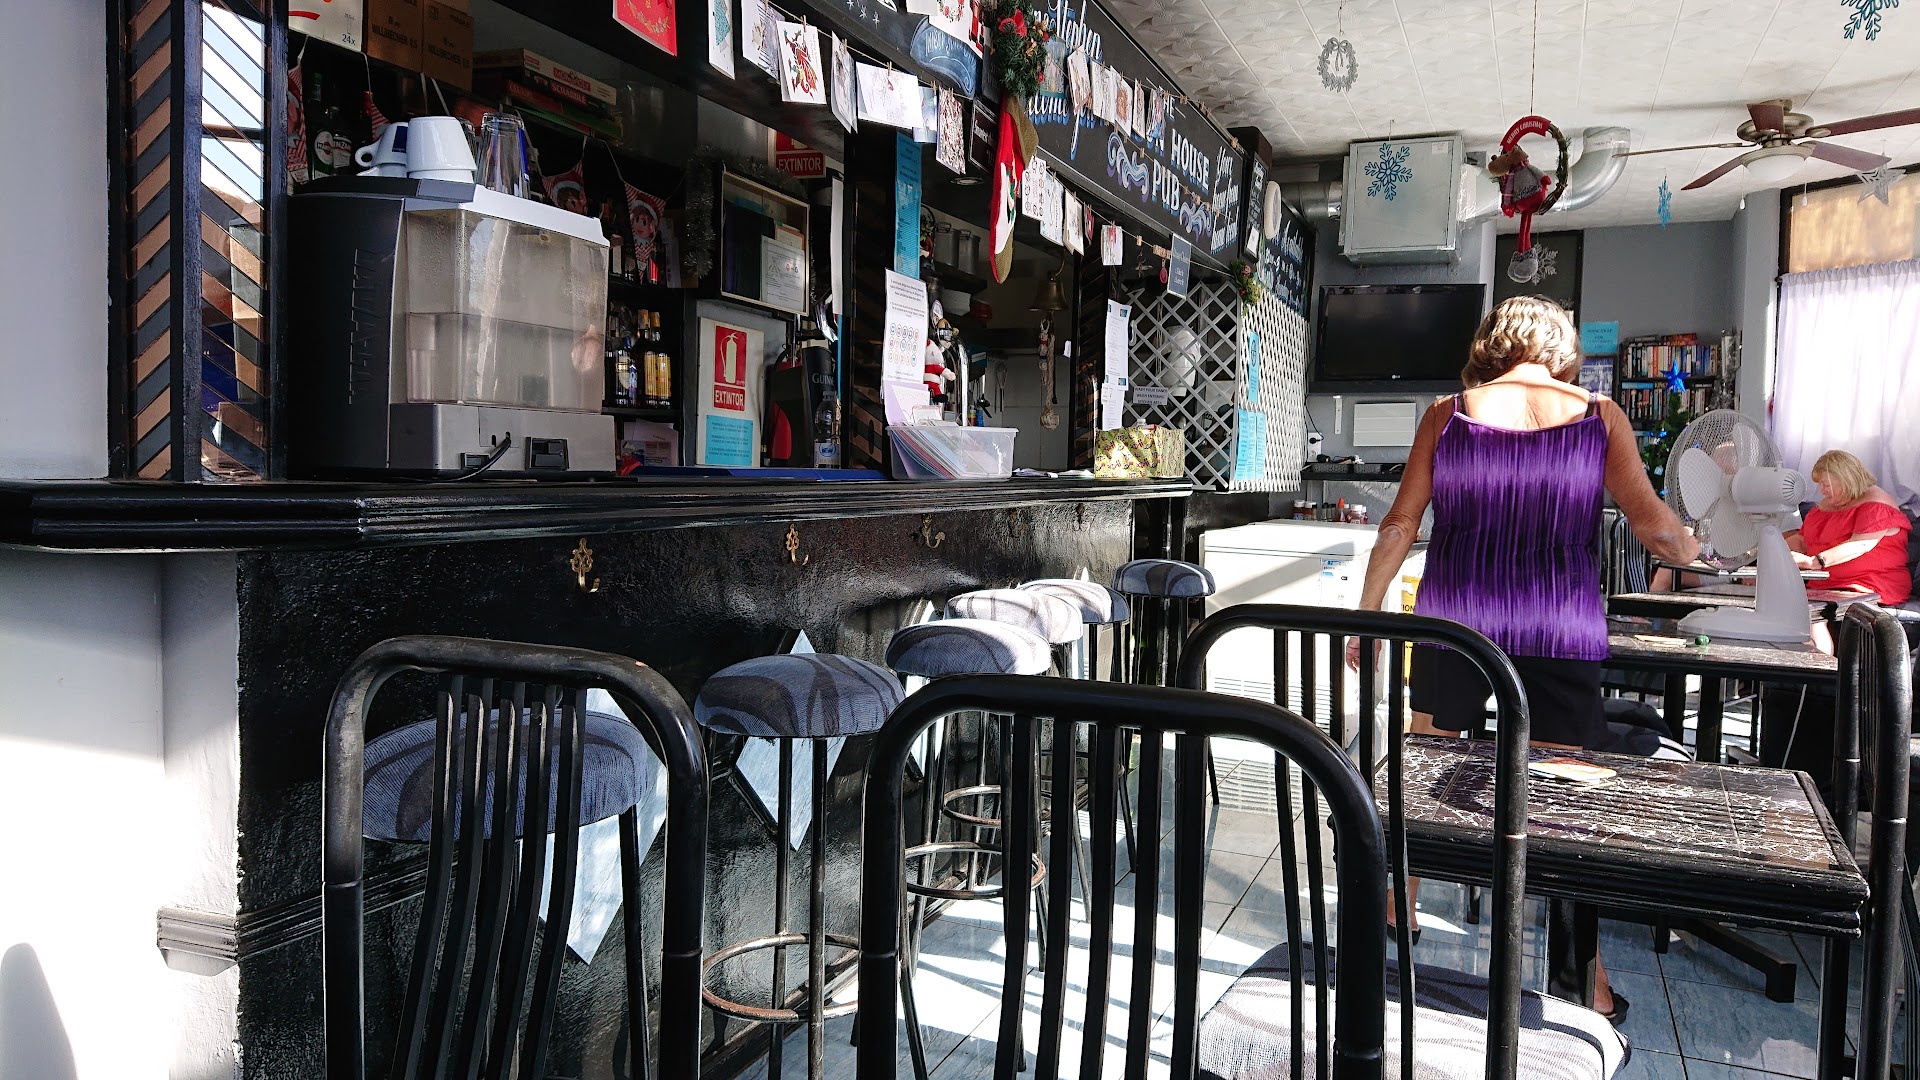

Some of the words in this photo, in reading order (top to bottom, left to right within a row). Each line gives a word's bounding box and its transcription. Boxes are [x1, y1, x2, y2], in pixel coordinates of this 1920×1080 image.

[342, 33, 356, 46] 24x
[1519, 120, 1544, 131] CHRISTMAS
[778, 156, 822, 172] EXTINTOR
[1171, 128, 1210, 192] HOUSE
[1153, 159, 1180, 213] PUB
[715, 389, 744, 407] EXTINTOR
